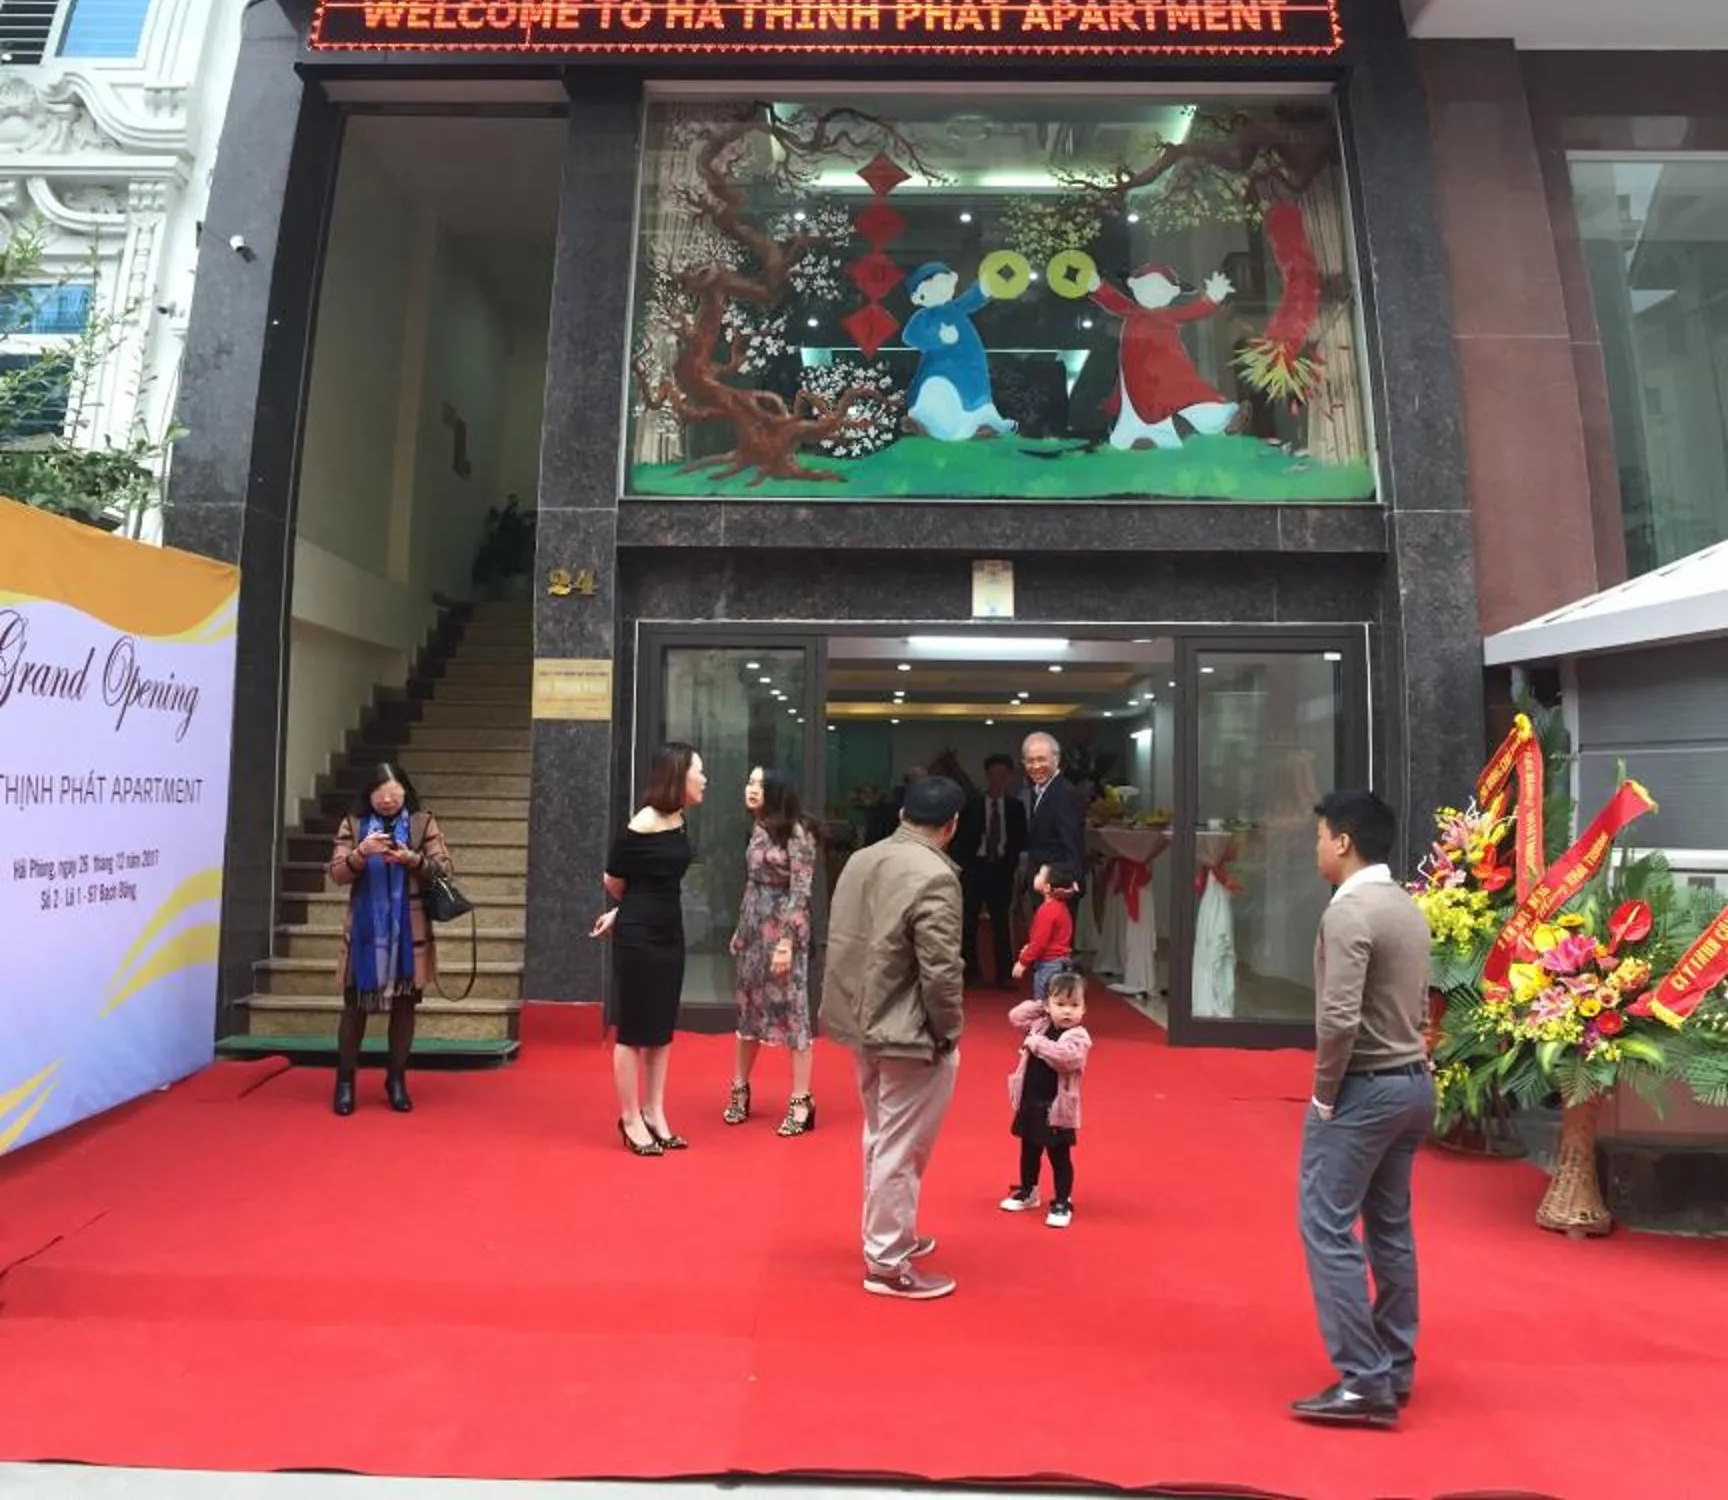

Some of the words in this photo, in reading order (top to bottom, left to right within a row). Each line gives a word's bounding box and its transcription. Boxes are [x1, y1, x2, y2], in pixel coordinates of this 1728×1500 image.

[102, 635, 200, 743] Opening
[60, 768, 107, 804] PHÁT
[110, 775, 204, 804] APARTMENT
